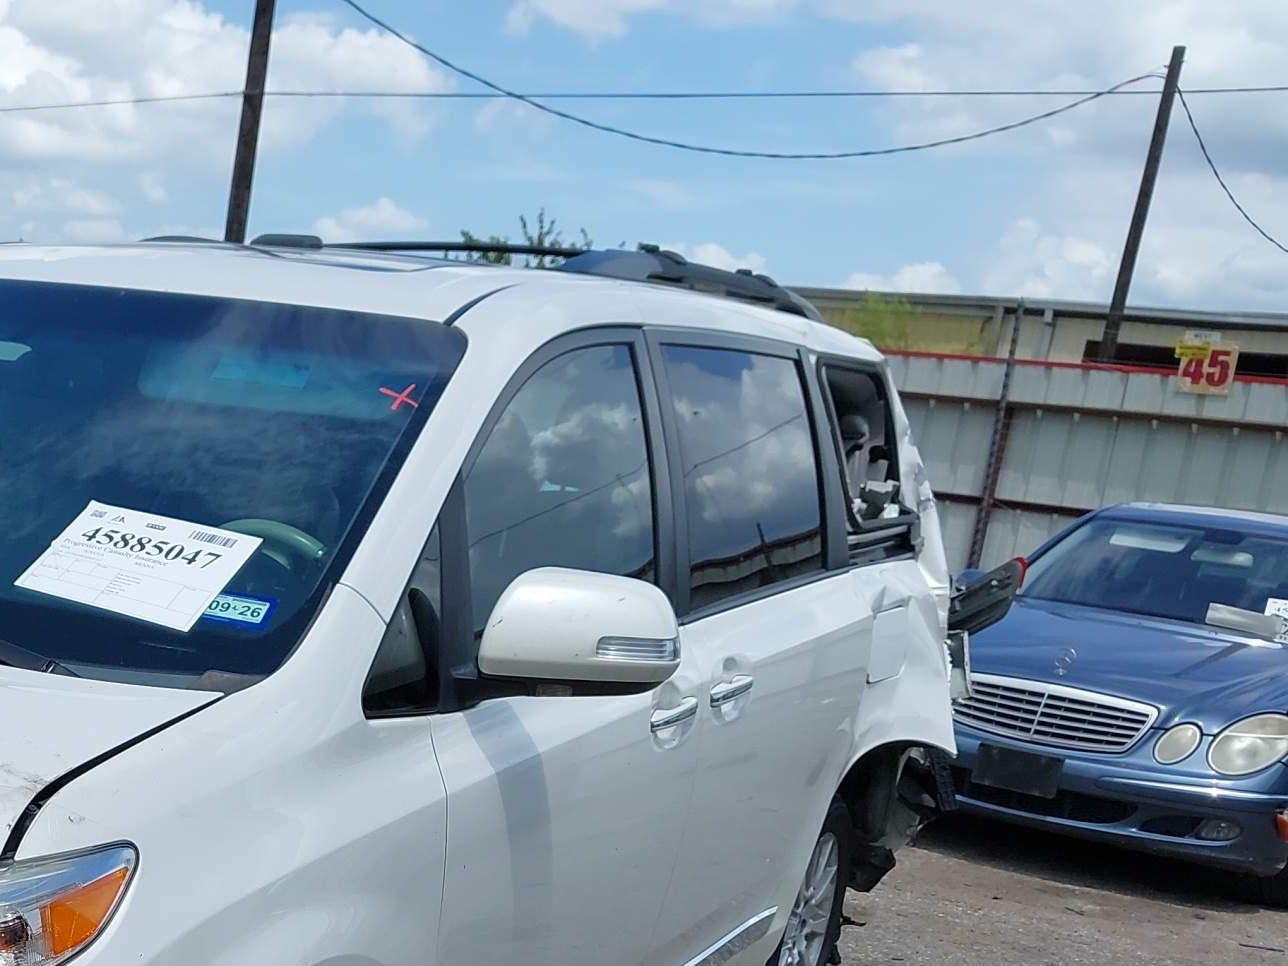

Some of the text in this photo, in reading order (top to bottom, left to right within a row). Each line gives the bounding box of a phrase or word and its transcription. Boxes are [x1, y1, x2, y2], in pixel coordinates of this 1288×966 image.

[1182, 350, 1231, 387] 45
[81, 526, 223, 568] 45885047
[238, 605, 263, 618] 26
